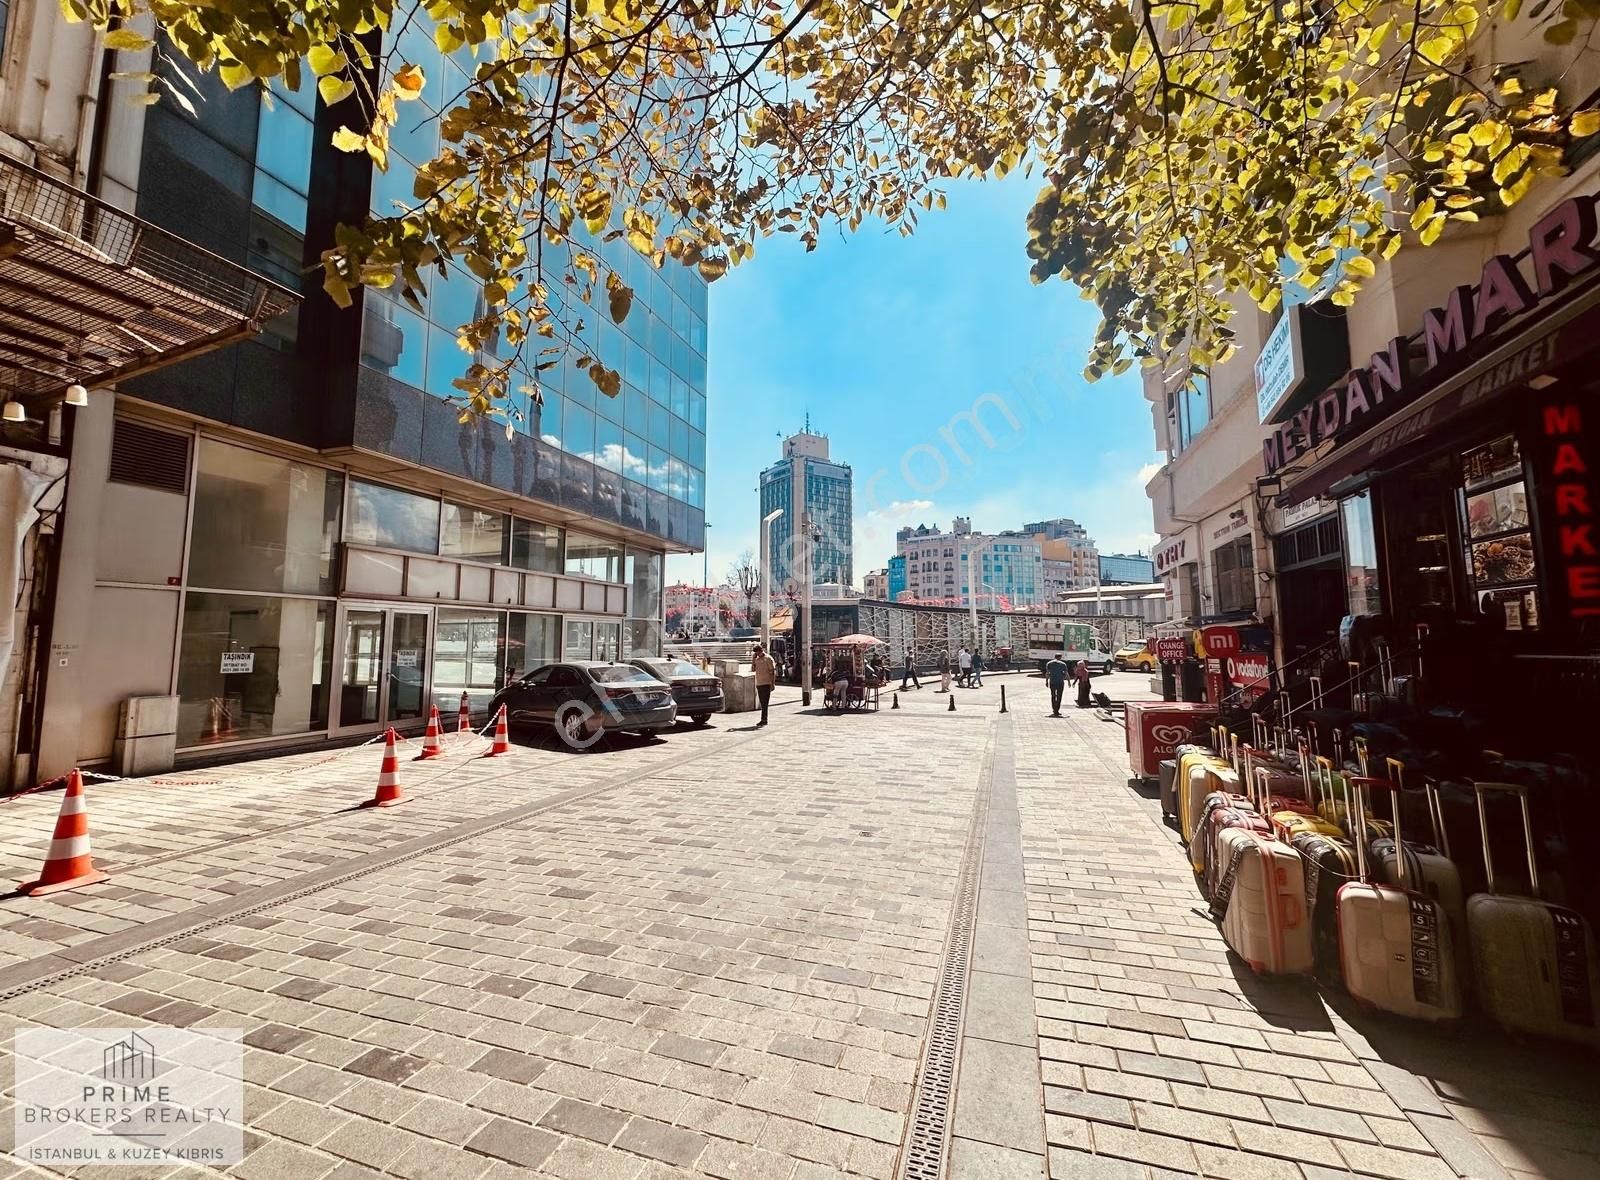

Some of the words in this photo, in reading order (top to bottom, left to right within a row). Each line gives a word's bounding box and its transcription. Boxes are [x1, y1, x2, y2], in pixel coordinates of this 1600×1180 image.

[1459, 331, 1560, 406] MARKET
[1263, 337, 1408, 475] MEYDAN
[1160, 641, 1185, 649] CHANGE
[1162, 650, 1184, 658] OFFICE
[1236, 658, 1269, 680] vodafone
[1153, 745, 1176, 754] ALGI
